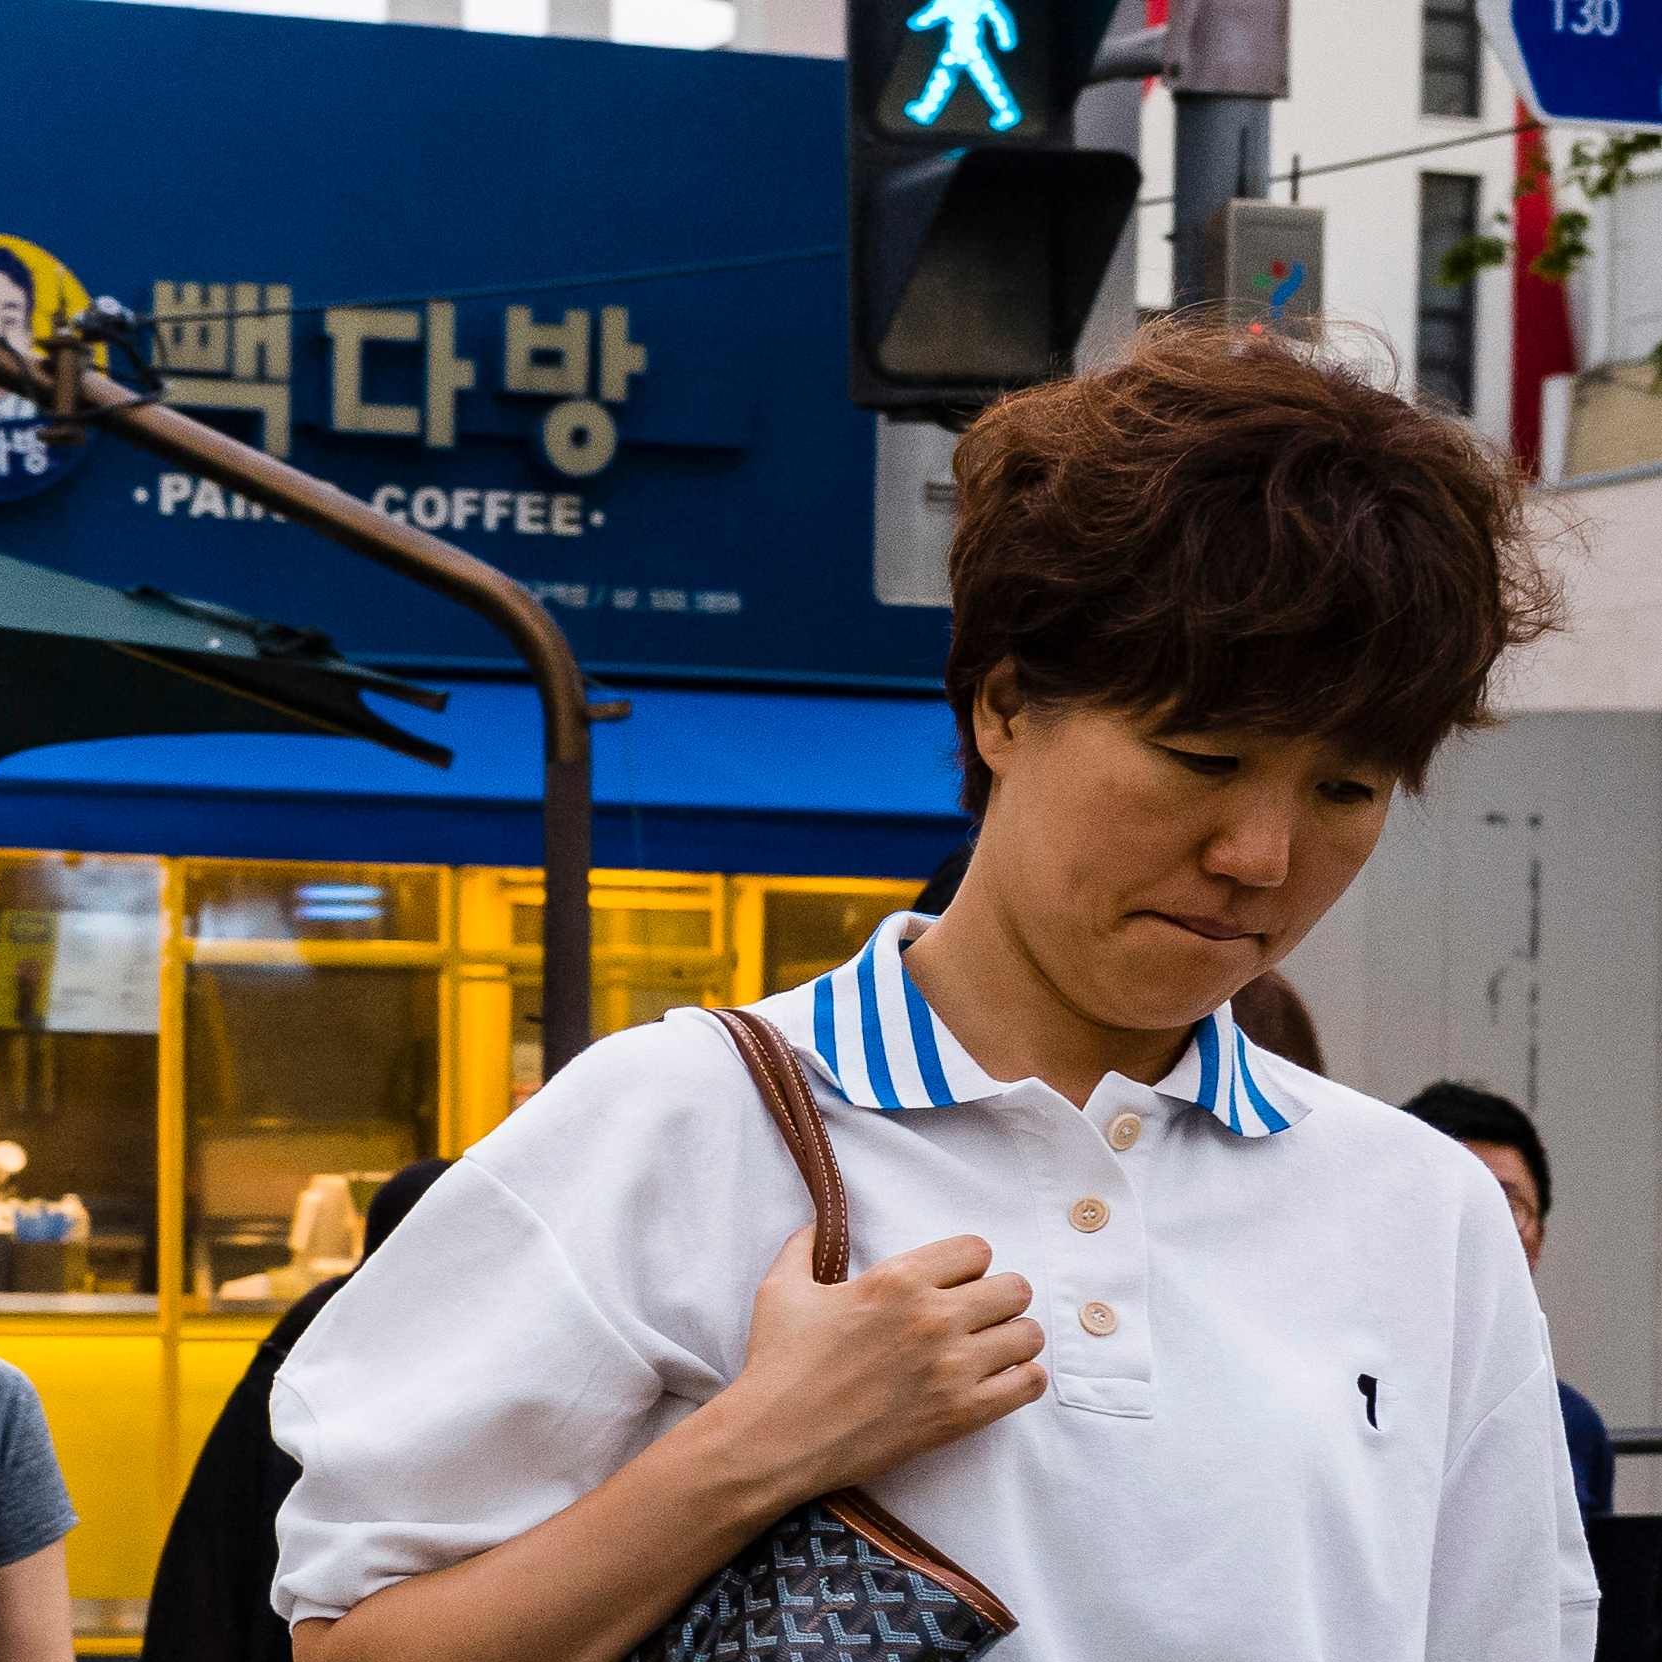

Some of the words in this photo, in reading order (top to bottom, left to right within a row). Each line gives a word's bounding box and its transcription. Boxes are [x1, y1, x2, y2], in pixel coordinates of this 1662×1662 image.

[1552, 0, 1621, 35] 130
[152, 279, 647, 477] 빽다방
[375, 484, 583, 535] COFFEE
